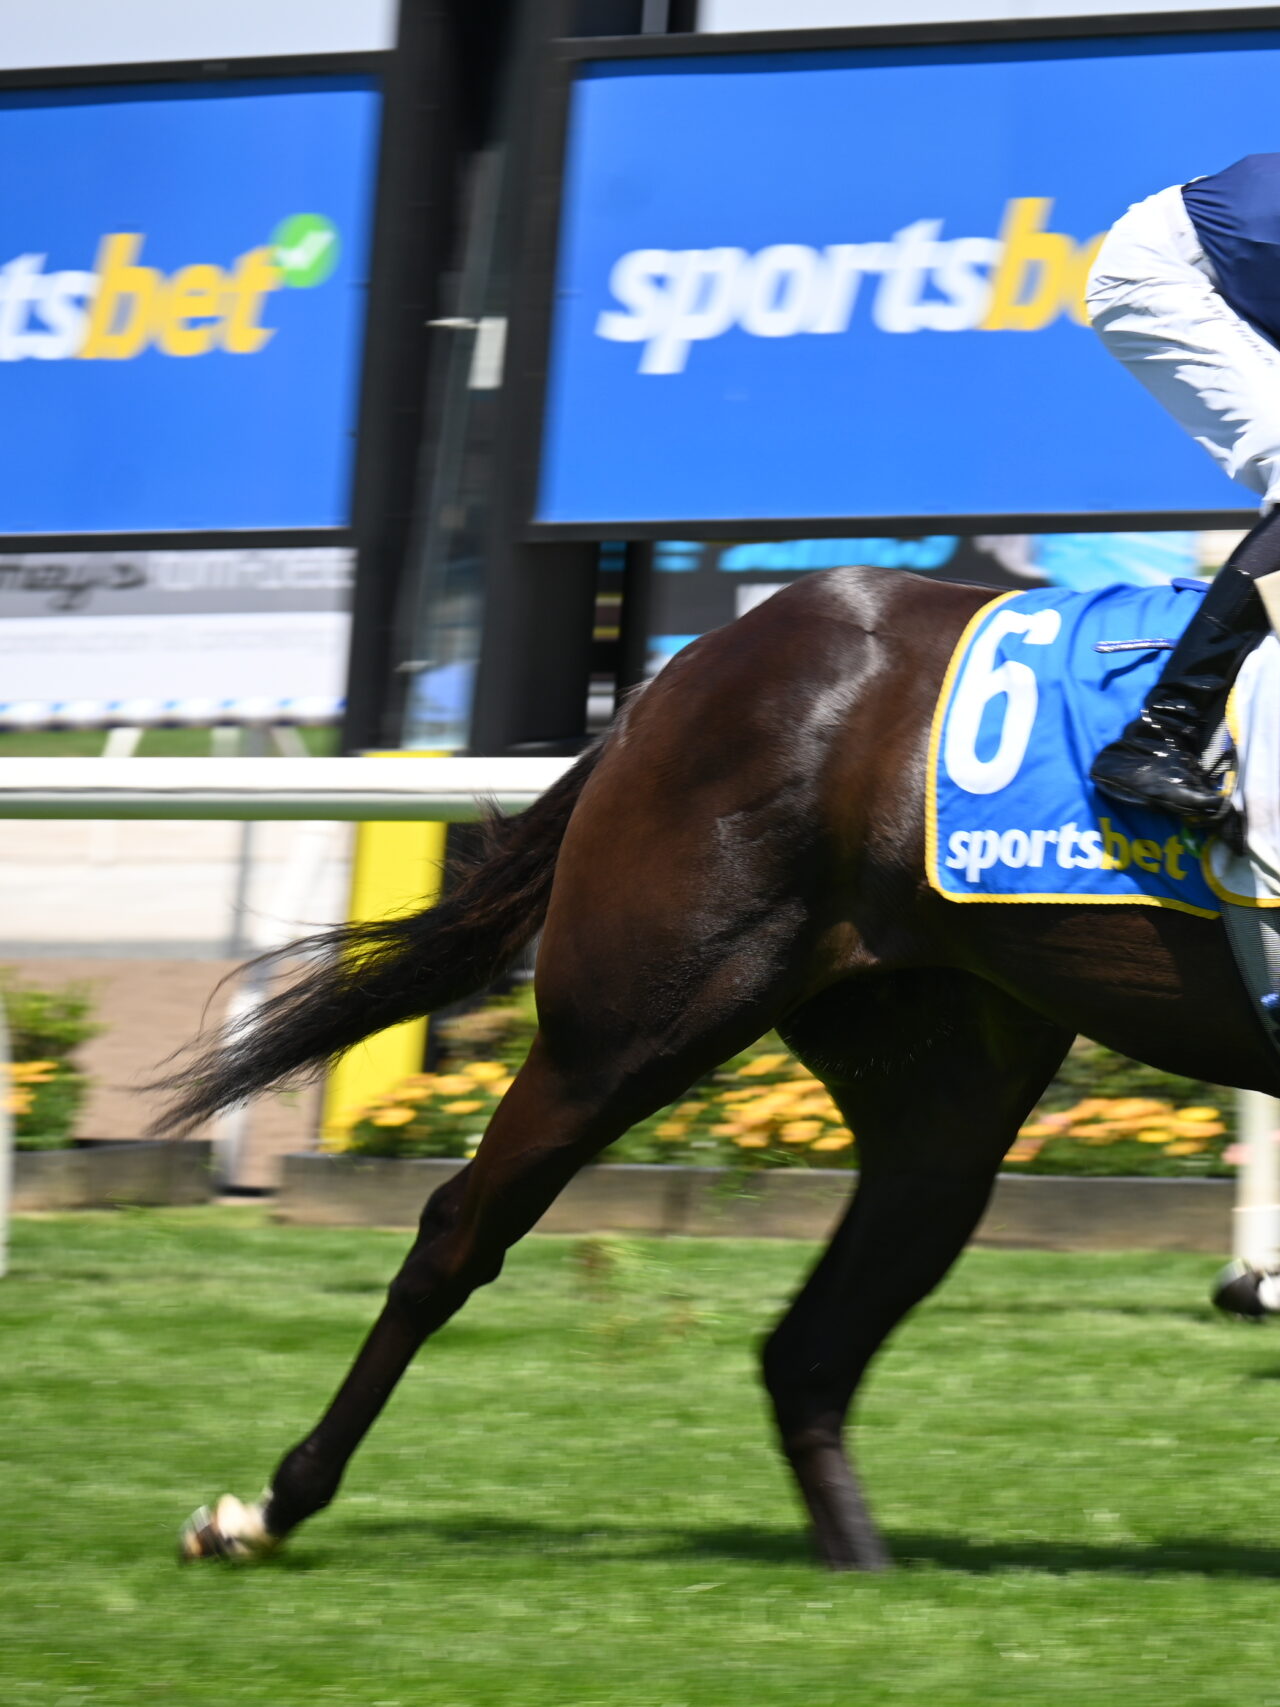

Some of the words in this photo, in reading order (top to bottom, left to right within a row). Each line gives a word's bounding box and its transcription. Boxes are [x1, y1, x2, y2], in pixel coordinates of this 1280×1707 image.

[595, 197, 1109, 374] sportsb
[944, 609, 1062, 795] 6
[945, 816, 1188, 883] sportsbet
